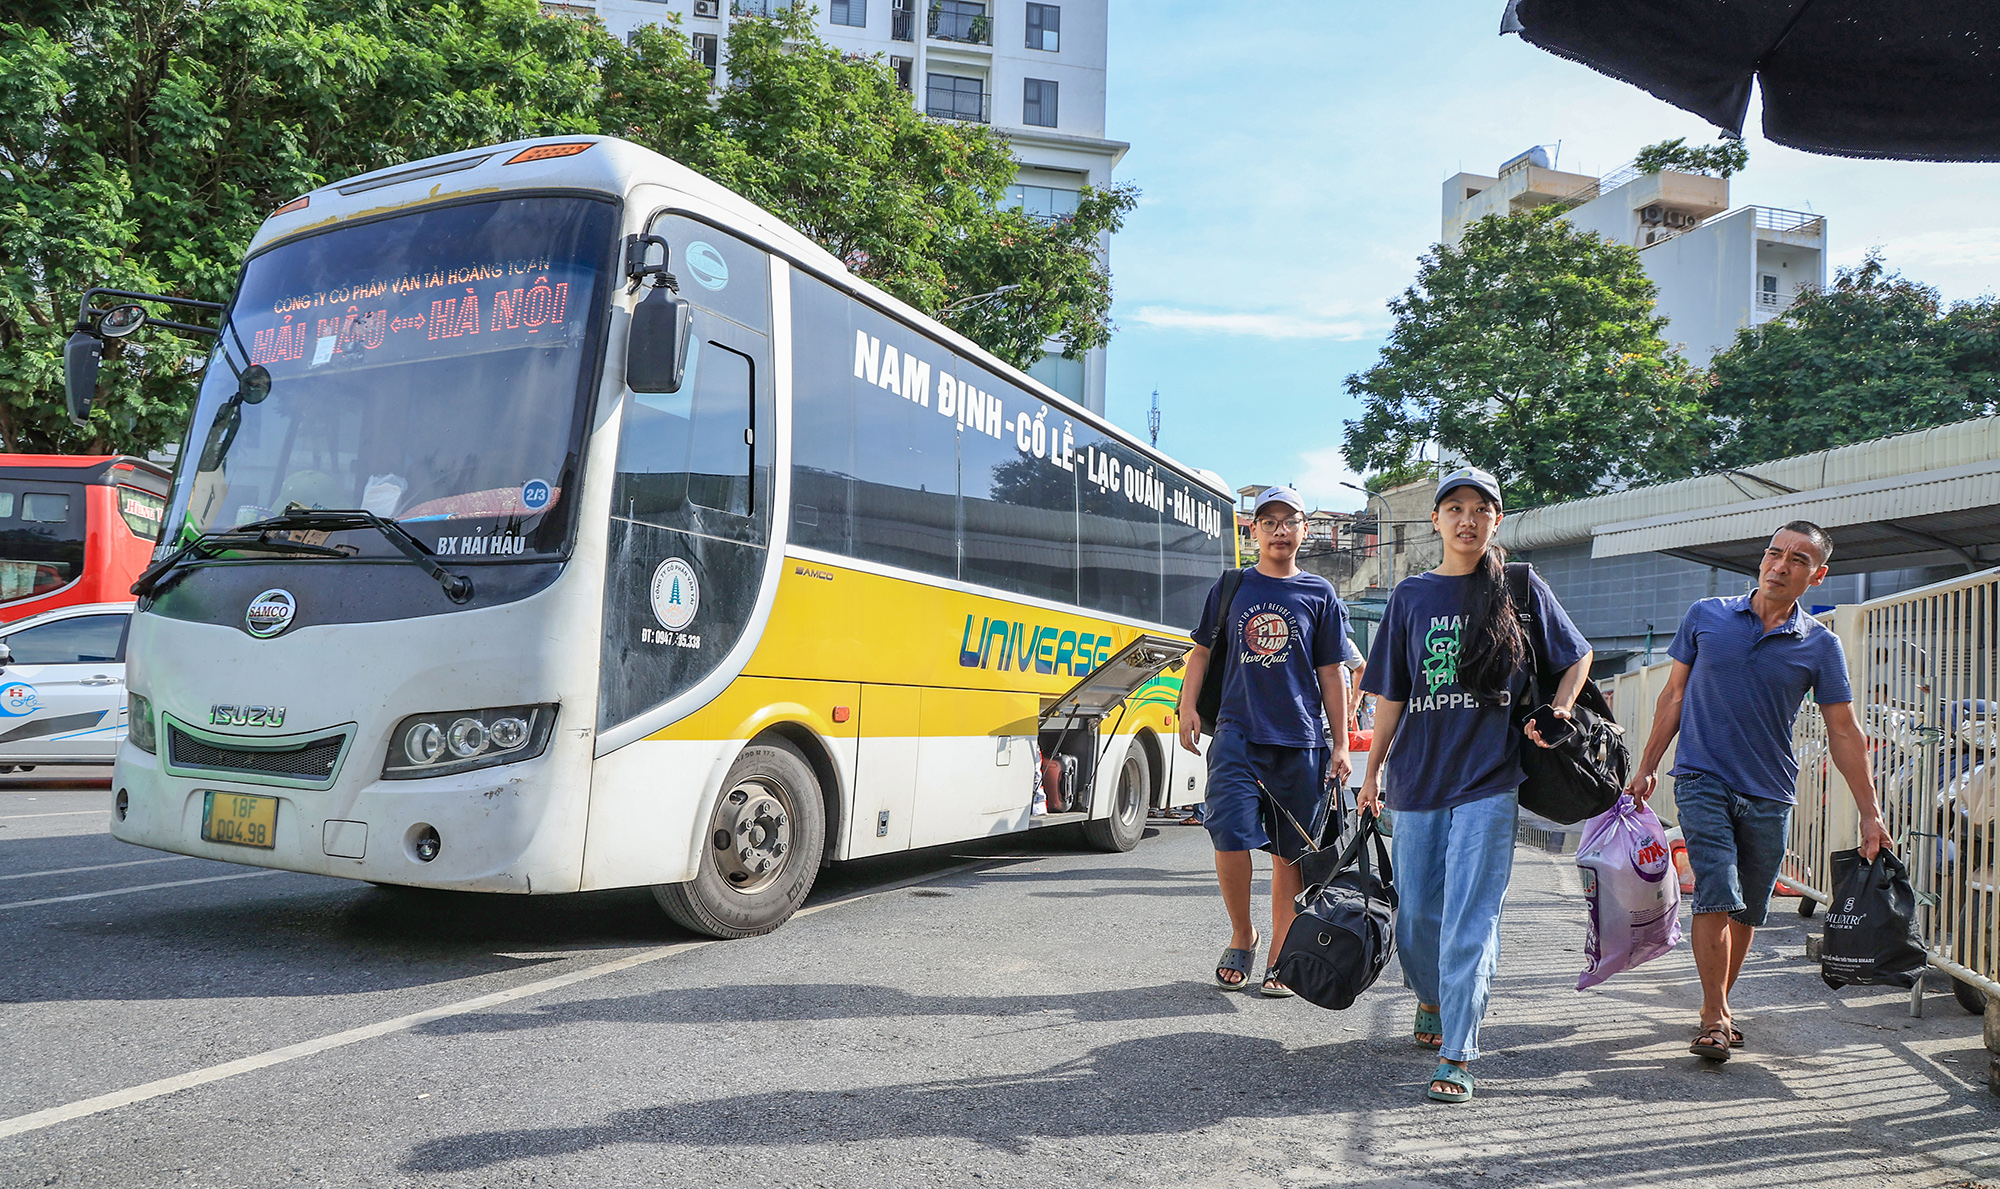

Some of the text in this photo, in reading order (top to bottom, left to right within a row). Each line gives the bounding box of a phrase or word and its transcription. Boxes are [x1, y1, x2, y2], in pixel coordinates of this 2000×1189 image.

[250, 314, 307, 366] HẢI
[428, 287, 480, 341] HÀ
[490, 276, 569, 334] NỘI
[853, 328, 931, 408] NAM
[937, 370, 1003, 440] ĐỊNH
[1016, 404, 1047, 460] CỔ
[1050, 419, 1075, 473] LỄ
[1087, 445, 1120, 494] LẠC
[1173, 485, 1196, 528] HẢI
[1197, 499, 1221, 541] HẬU
[525, 486, 547, 501] 2/3
[436, 526, 526, 558] BX HẢI HẬU
[795, 566, 834, 581] SAMCO
[249, 605, 289, 618] SAMCO
[1248, 604, 1261, 614] WIN
[1268, 602, 1291, 618] REFUSE
[959, 614, 1112, 677] UNIVERSE
[1261, 651, 1290, 669] Quit
[209, 704, 286, 727] ISUZU
[232, 797, 258, 818] 18F
[217, 819, 267, 844] 004.98
